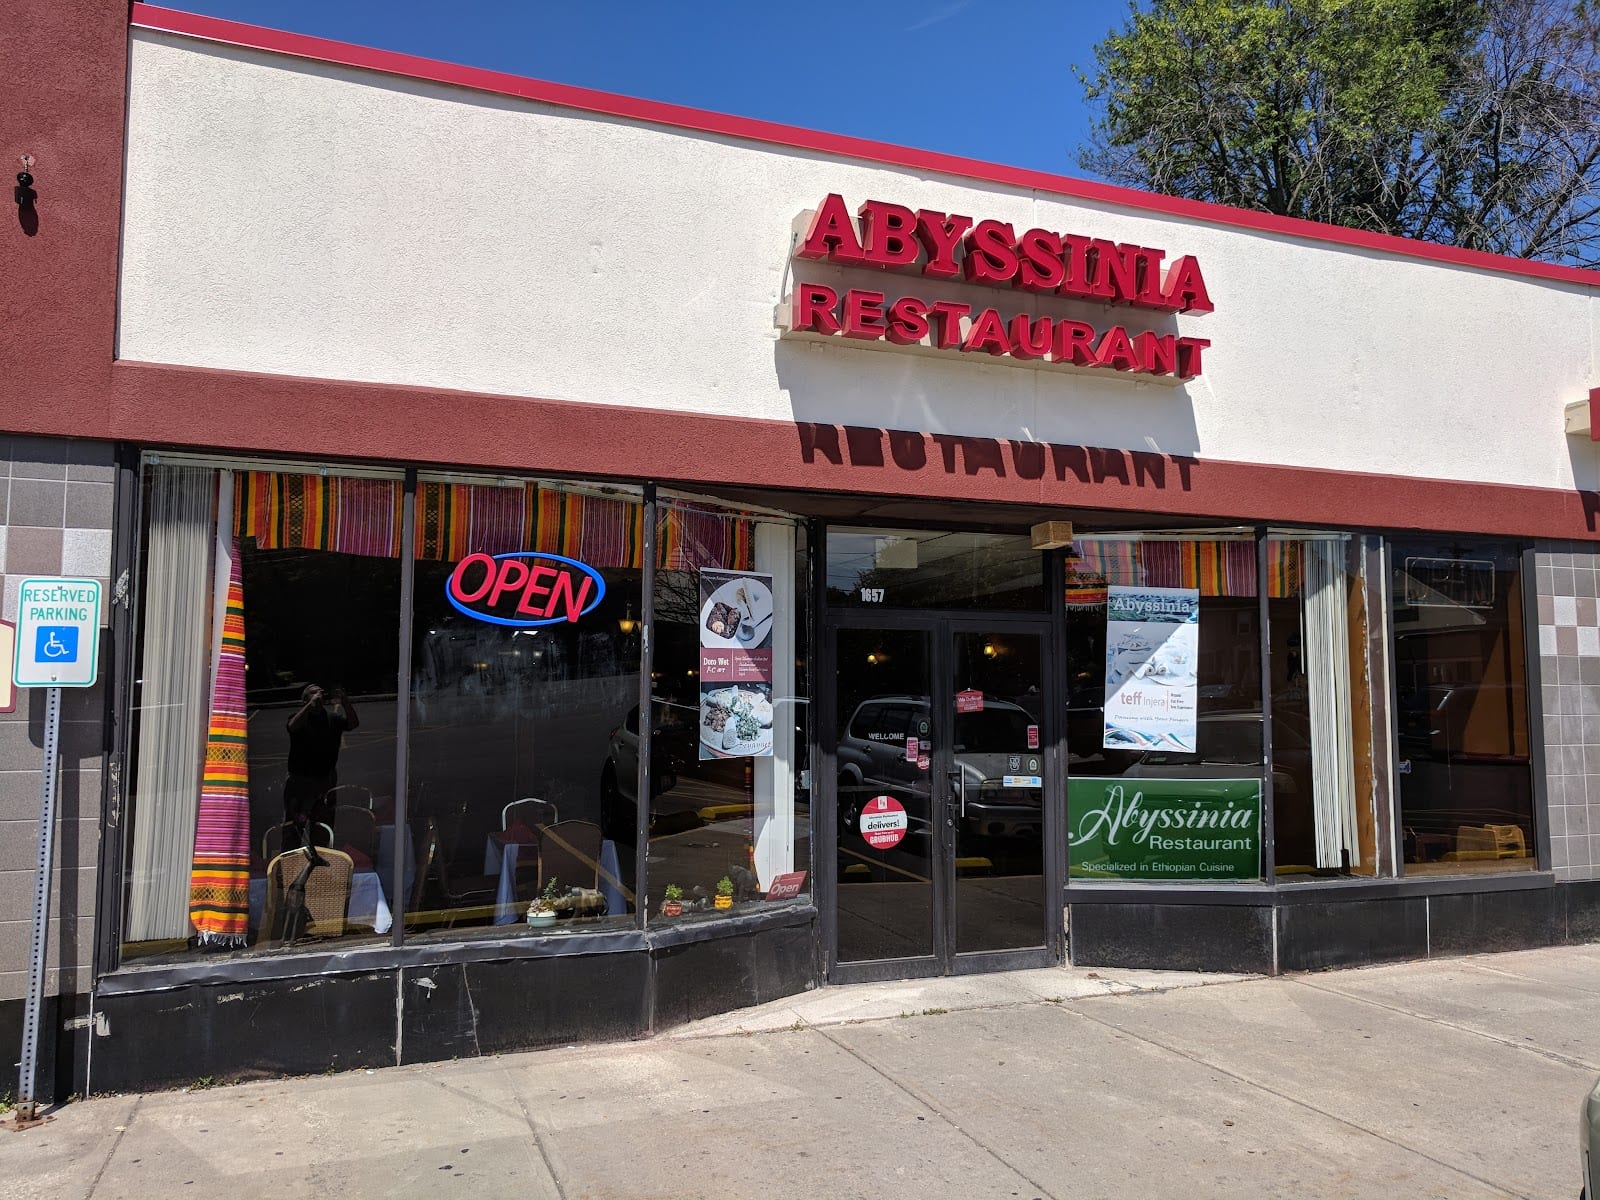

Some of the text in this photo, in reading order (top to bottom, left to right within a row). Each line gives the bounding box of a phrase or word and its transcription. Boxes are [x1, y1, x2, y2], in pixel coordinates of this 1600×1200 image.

[795, 193, 1214, 316] ABYSSINIA
[793, 283, 1211, 380] RESTAURANT
[451, 553, 592, 623] OPEN
[860, 587, 885, 603] 1657
[24, 589, 95, 603] RESERVED
[1113, 597, 1190, 614] Abyssinia
[30, 608, 88, 621] PARKING
[1120, 691, 1142, 705] teff
[868, 732, 905, 741] WELCOME
[1068, 785, 1252, 846] Abyssinia
[867, 819, 900, 830] delivers!
[1149, 835, 1252, 850] Restaurant
[1081, 861, 1235, 873] Specialized in Ethiopian Cuisine
[770, 883, 800, 897] Open
